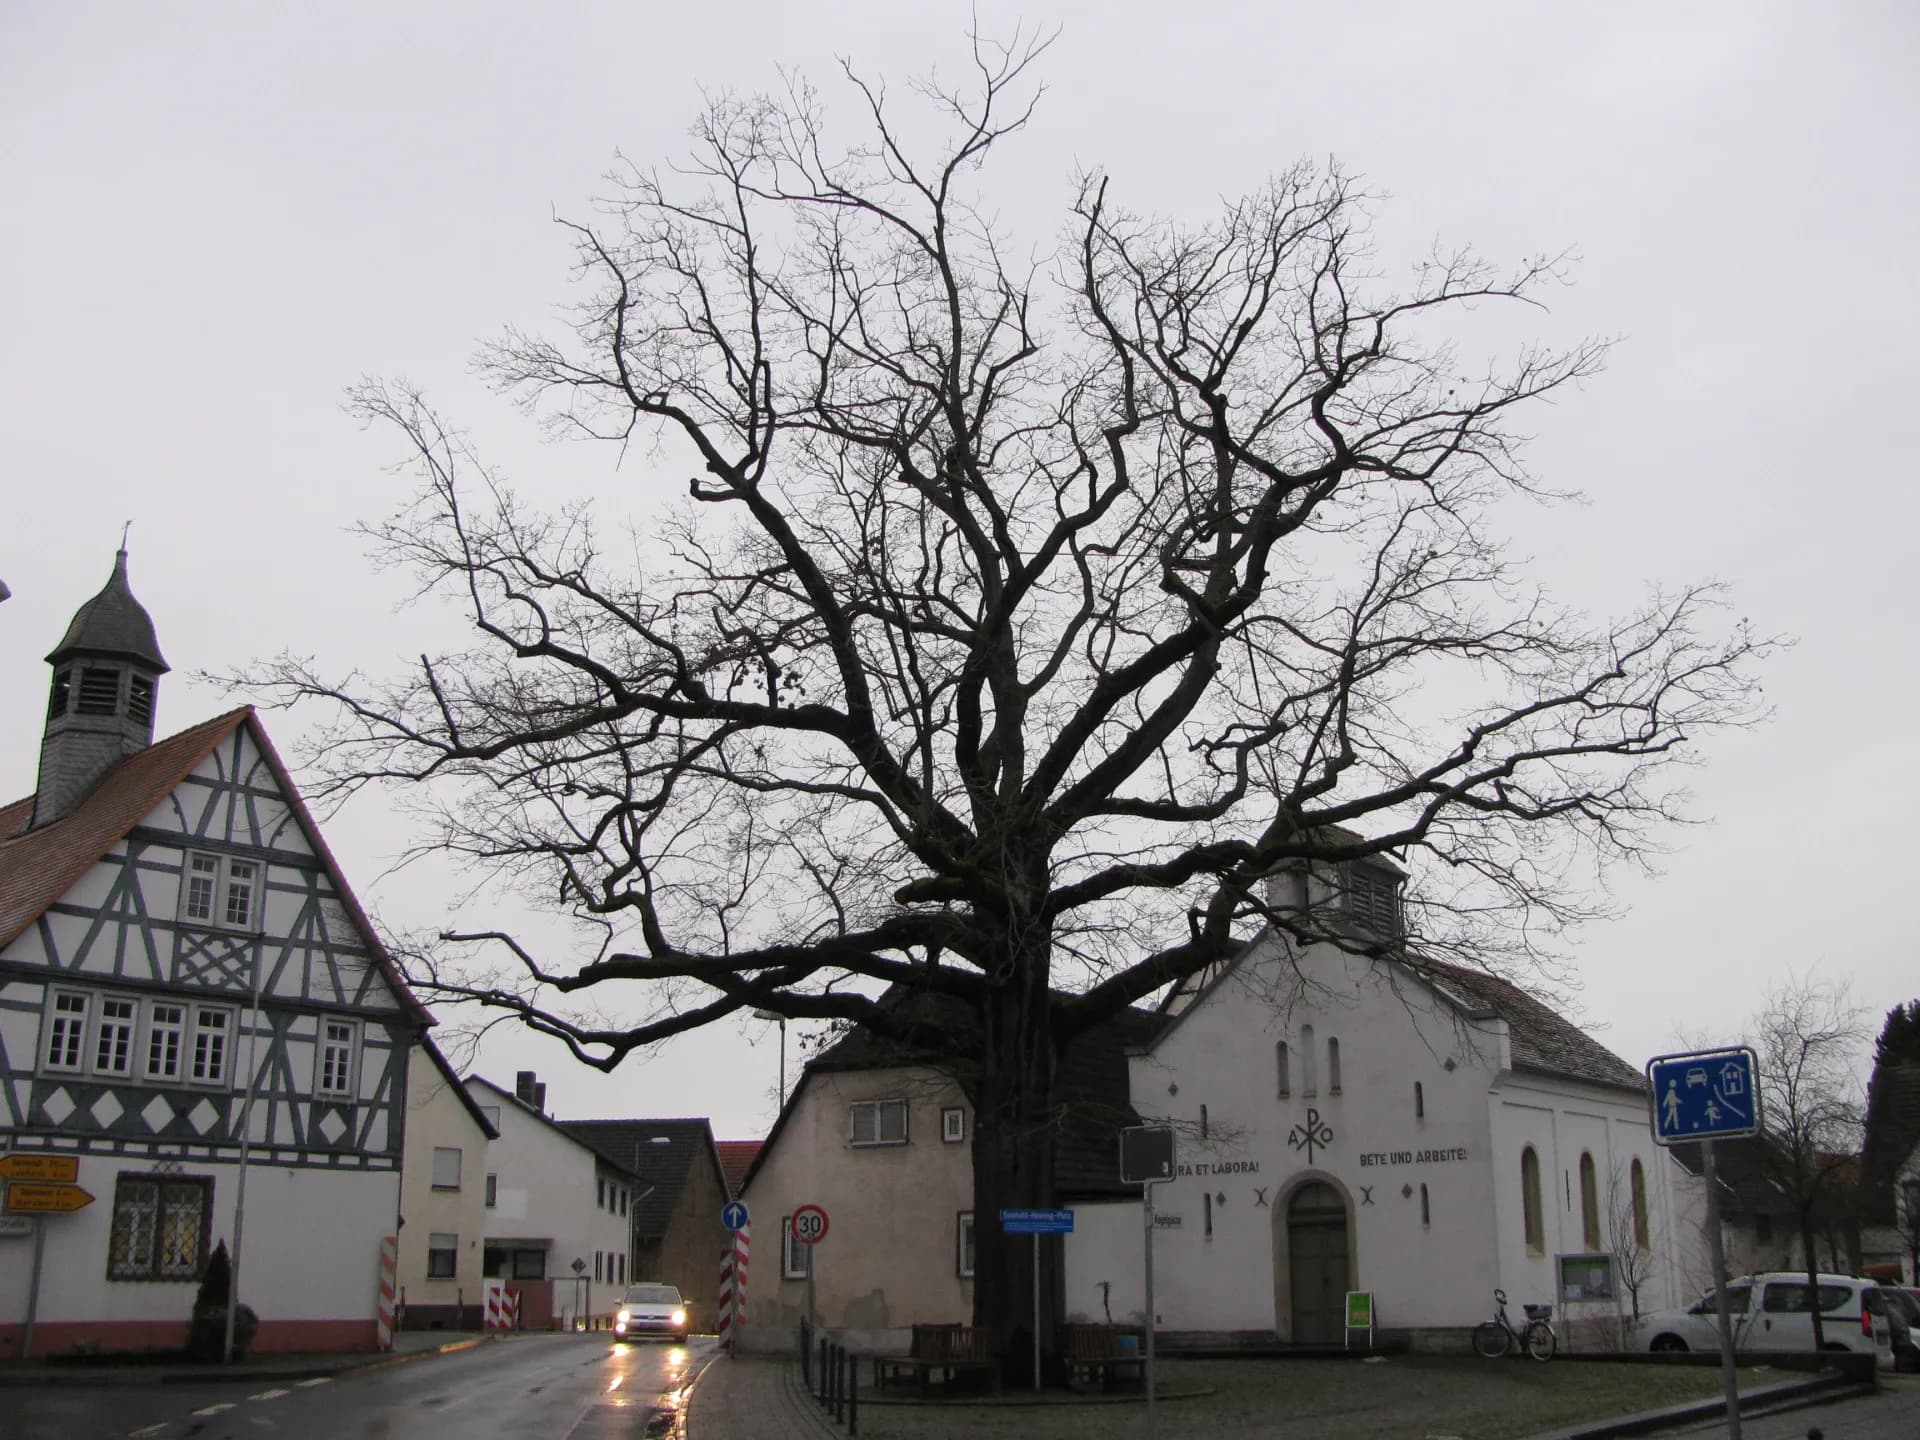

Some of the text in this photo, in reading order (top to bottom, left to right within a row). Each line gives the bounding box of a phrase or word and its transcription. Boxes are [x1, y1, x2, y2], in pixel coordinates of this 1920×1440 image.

[1360, 1148, 1467, 1167] BETE UND ARBEITE!
[1177, 1160, 1259, 1177] RA ET LABORA!
[799, 1215, 821, 1233] 30
